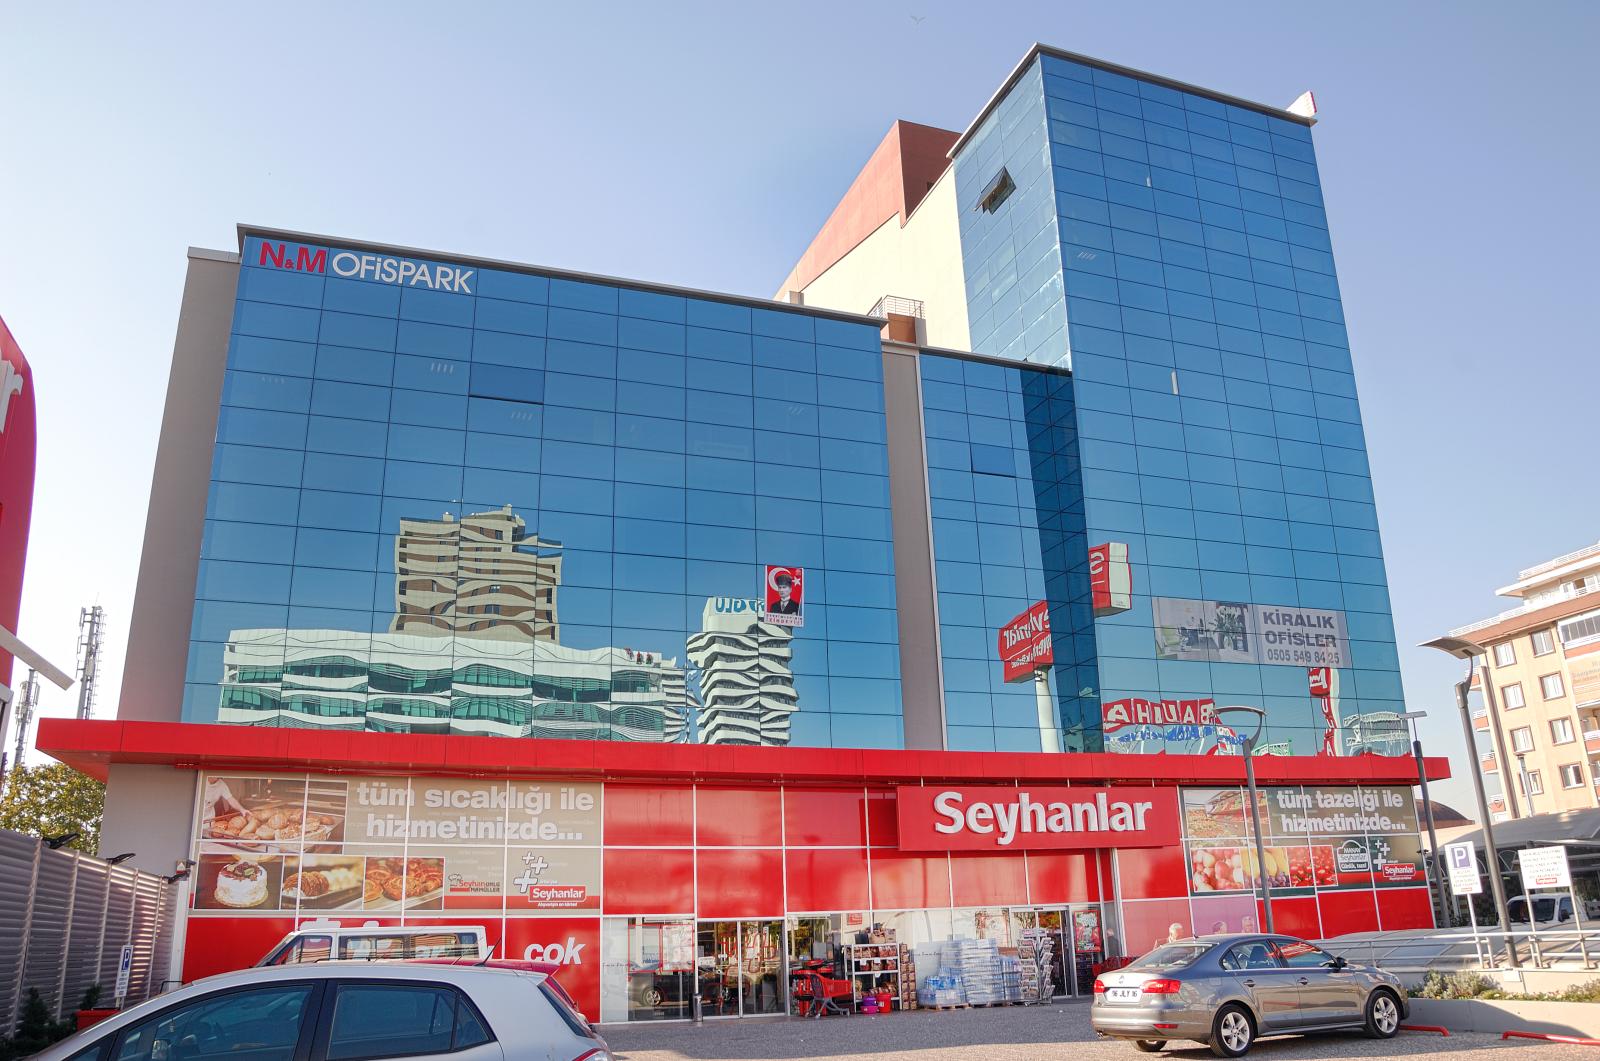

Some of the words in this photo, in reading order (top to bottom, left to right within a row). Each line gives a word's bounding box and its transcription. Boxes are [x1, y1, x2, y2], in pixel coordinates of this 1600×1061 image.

[259, 242, 327, 273] N&M
[1262, 608, 1335, 629] KİRALIK
[1264, 628, 1337, 648] OFİSLER
[1267, 649, 1291, 661] 0505
[1293, 649, 1312, 663] 549
[1314, 651, 1326, 663] 84
[1327, 652, 1340, 664] 25
[356, 782, 415, 806] tüm
[424, 785, 551, 815] sıcaklığı
[560, 787, 594, 811] ile
[1277, 790, 1312, 809] tüm
[1316, 789, 1380, 812] tazeliği
[1383, 789, 1404, 808] ile
[934, 791, 1153, 845] Seyhanlar
[1454, 847, 1466, 867] P
[1384, 865, 1415, 876] Seyhanlar
[532, 887, 584, 901] Seyhanlar
